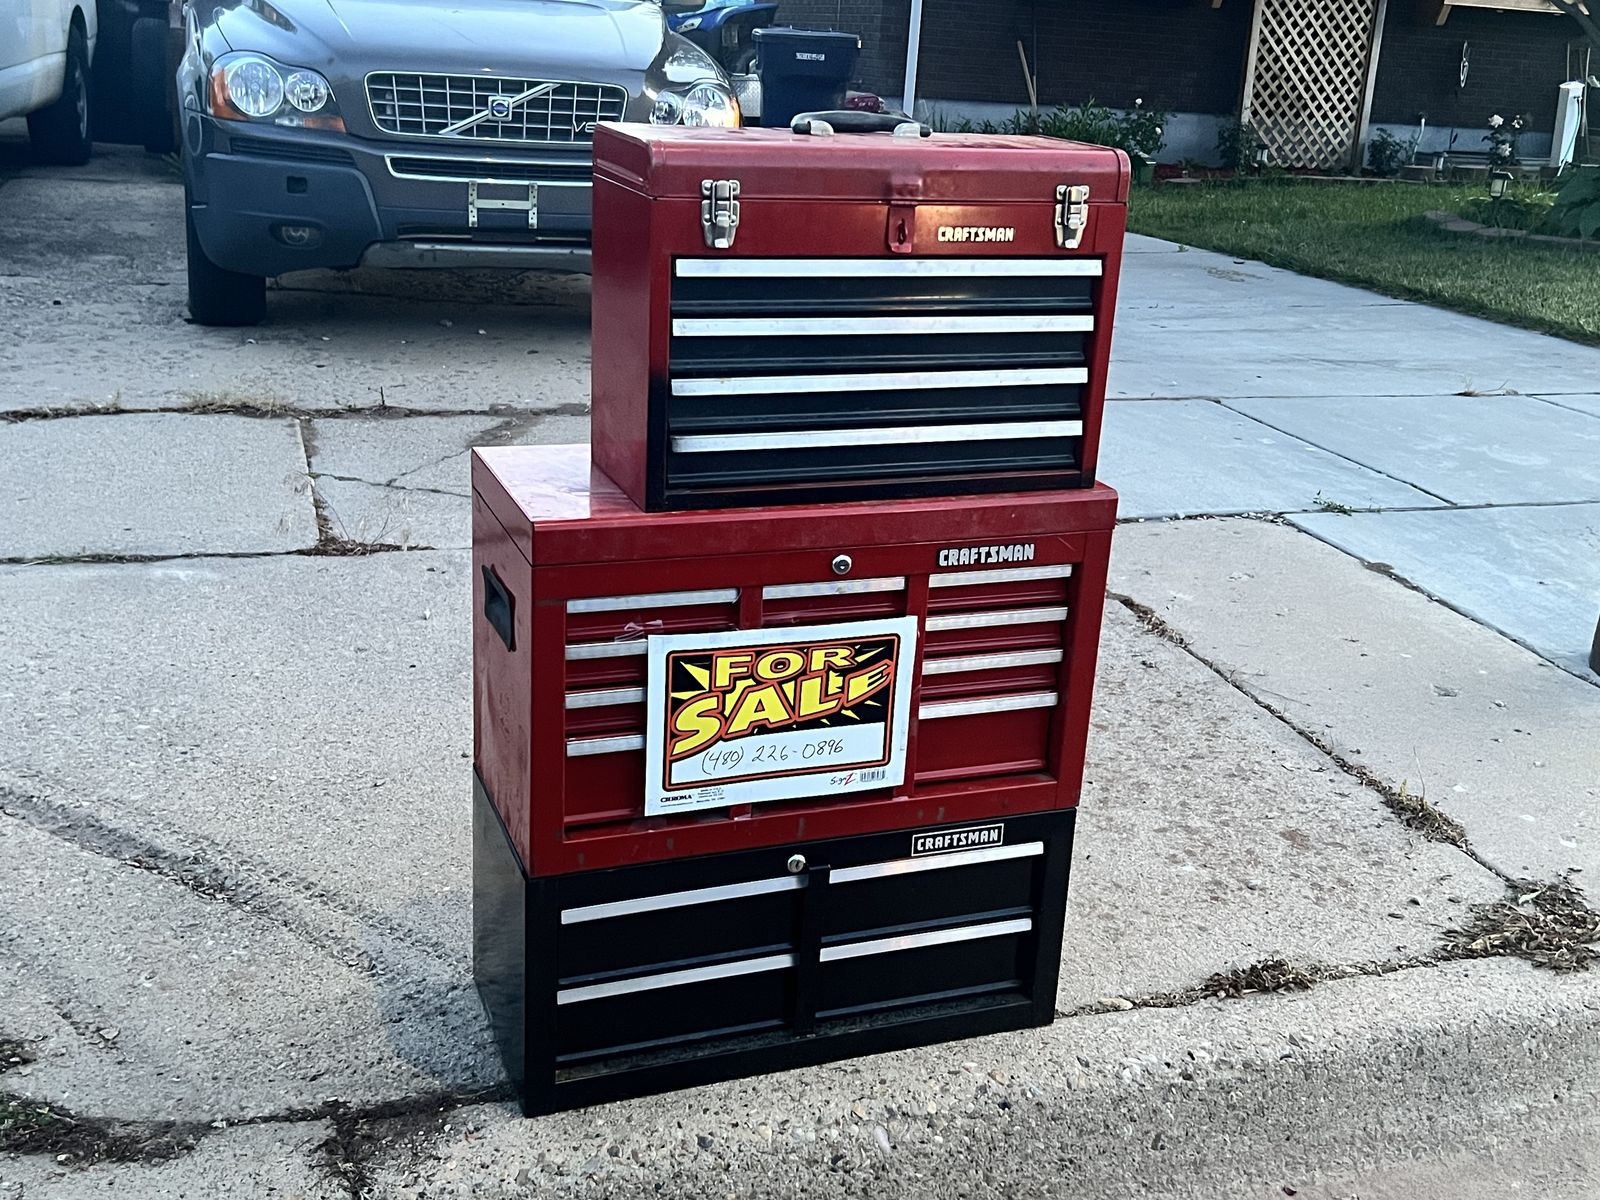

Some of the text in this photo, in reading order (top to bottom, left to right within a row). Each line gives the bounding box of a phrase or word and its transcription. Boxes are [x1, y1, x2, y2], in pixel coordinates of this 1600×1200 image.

[937, 226, 1015, 242] CRAFTSMAN
[938, 543, 1035, 567] CRAFTSMAN
[713, 646, 856, 689] FOR
[671, 661, 891, 757] SALE
[701, 738, 844, 775] (480) 226-0896
[916, 828, 999, 851] CRAFTSMAN
